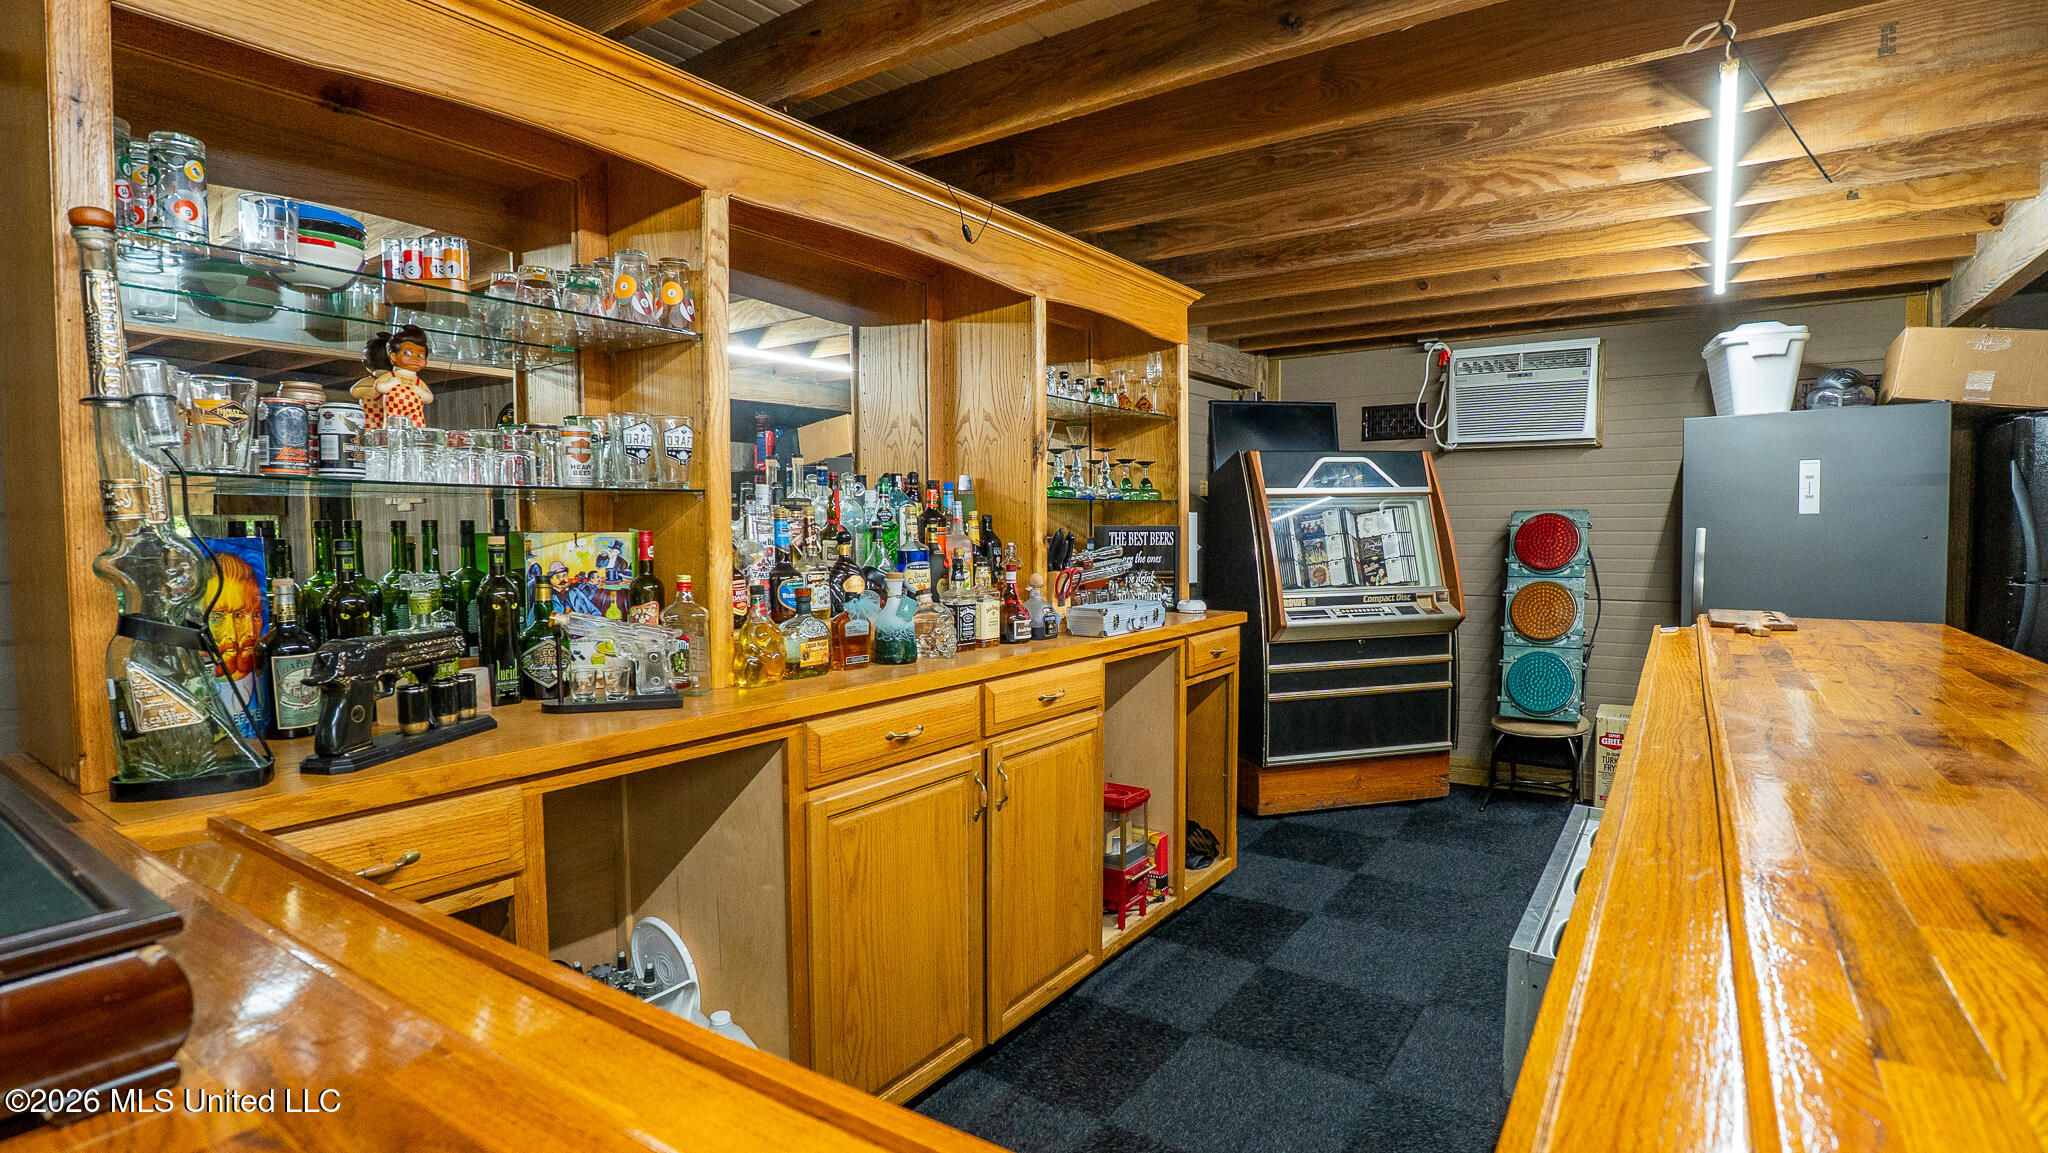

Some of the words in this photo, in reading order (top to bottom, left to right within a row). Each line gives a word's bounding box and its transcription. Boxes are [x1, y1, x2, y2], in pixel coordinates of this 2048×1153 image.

[1109, 531, 1126, 546] THE
[1128, 531, 1149, 546] BEST
[1150, 531, 1175, 546] BEERS
[1135, 550, 1145, 564] the
[1146, 555, 1162, 564] ones
[1363, 594, 1395, 603] Compact
[1396, 593, 1411, 601] Disc
[1602, 738, 1623, 746] GRIL
